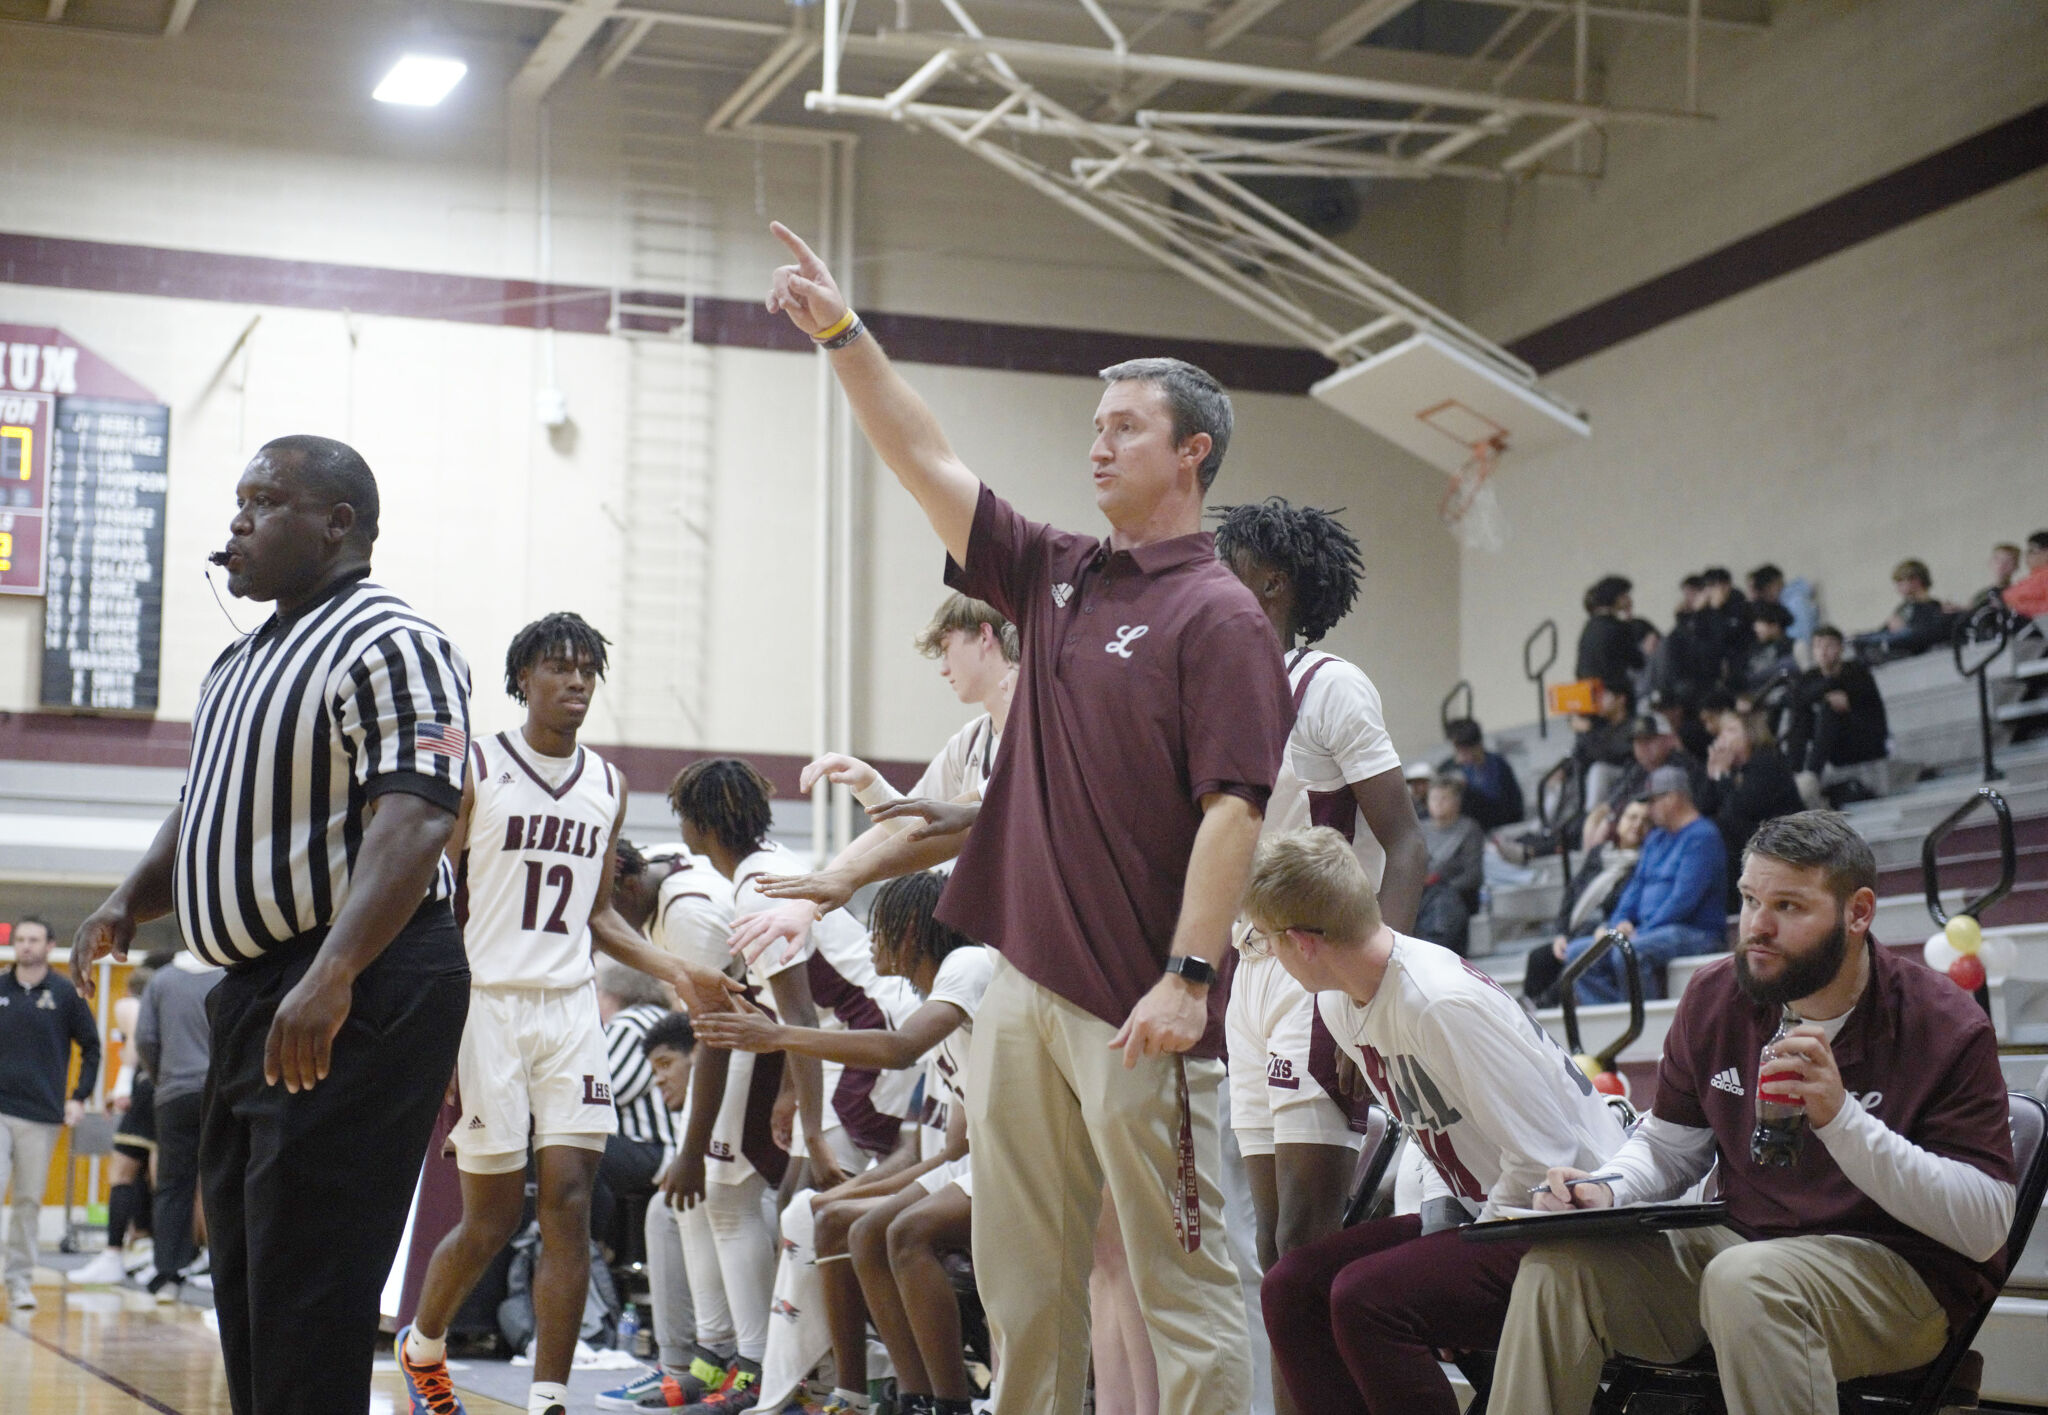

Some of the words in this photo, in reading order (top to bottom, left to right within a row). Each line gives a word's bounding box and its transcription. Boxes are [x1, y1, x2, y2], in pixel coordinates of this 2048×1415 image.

[0, 340, 78, 394] UM
[1105, 625, 1149, 659] L
[502, 814, 602, 860] REBELS
[521, 860, 574, 935] 12
[582, 1074, 611, 1107] LHS
[1710, 1077, 1744, 1096] adidas
